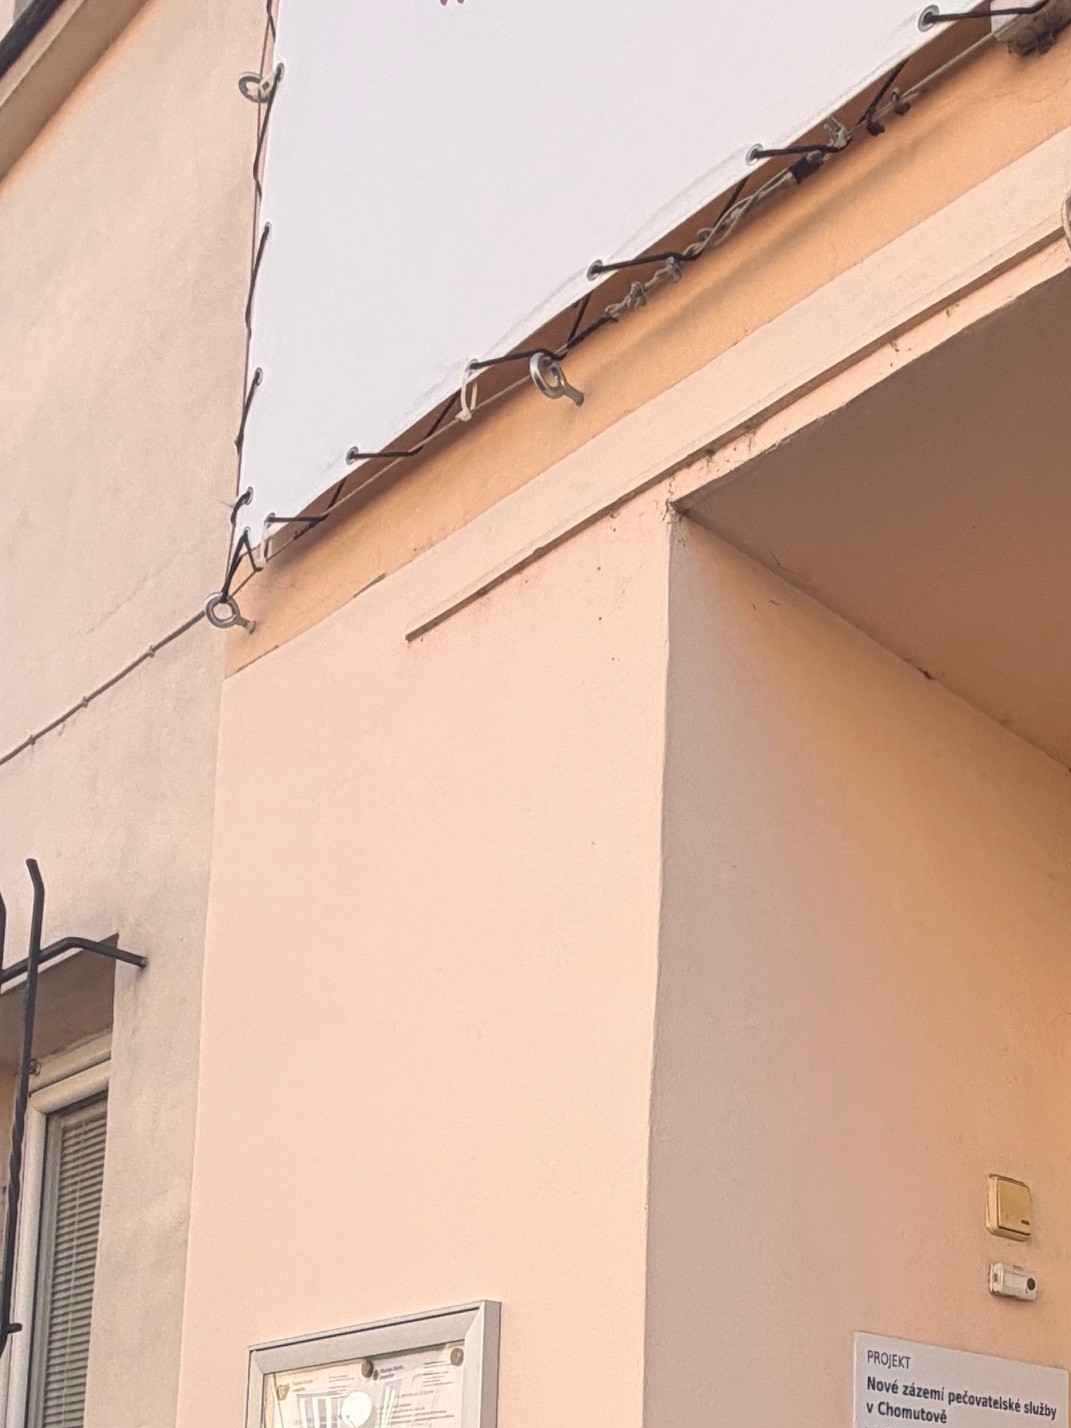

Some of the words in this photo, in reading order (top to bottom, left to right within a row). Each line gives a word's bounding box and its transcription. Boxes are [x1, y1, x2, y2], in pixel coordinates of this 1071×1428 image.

[867, 1349, 911, 1370] PROJEKT
[867, 1376, 899, 1394] Nové
[902, 1381, 945, 1401] zázemí
[947, 1389, 1021, 1413] pečovatelské
[1023, 1400, 1058, 1421] služby
[866, 1402, 874, 1414] v
[877, 1401, 948, 1424] Chomutově
